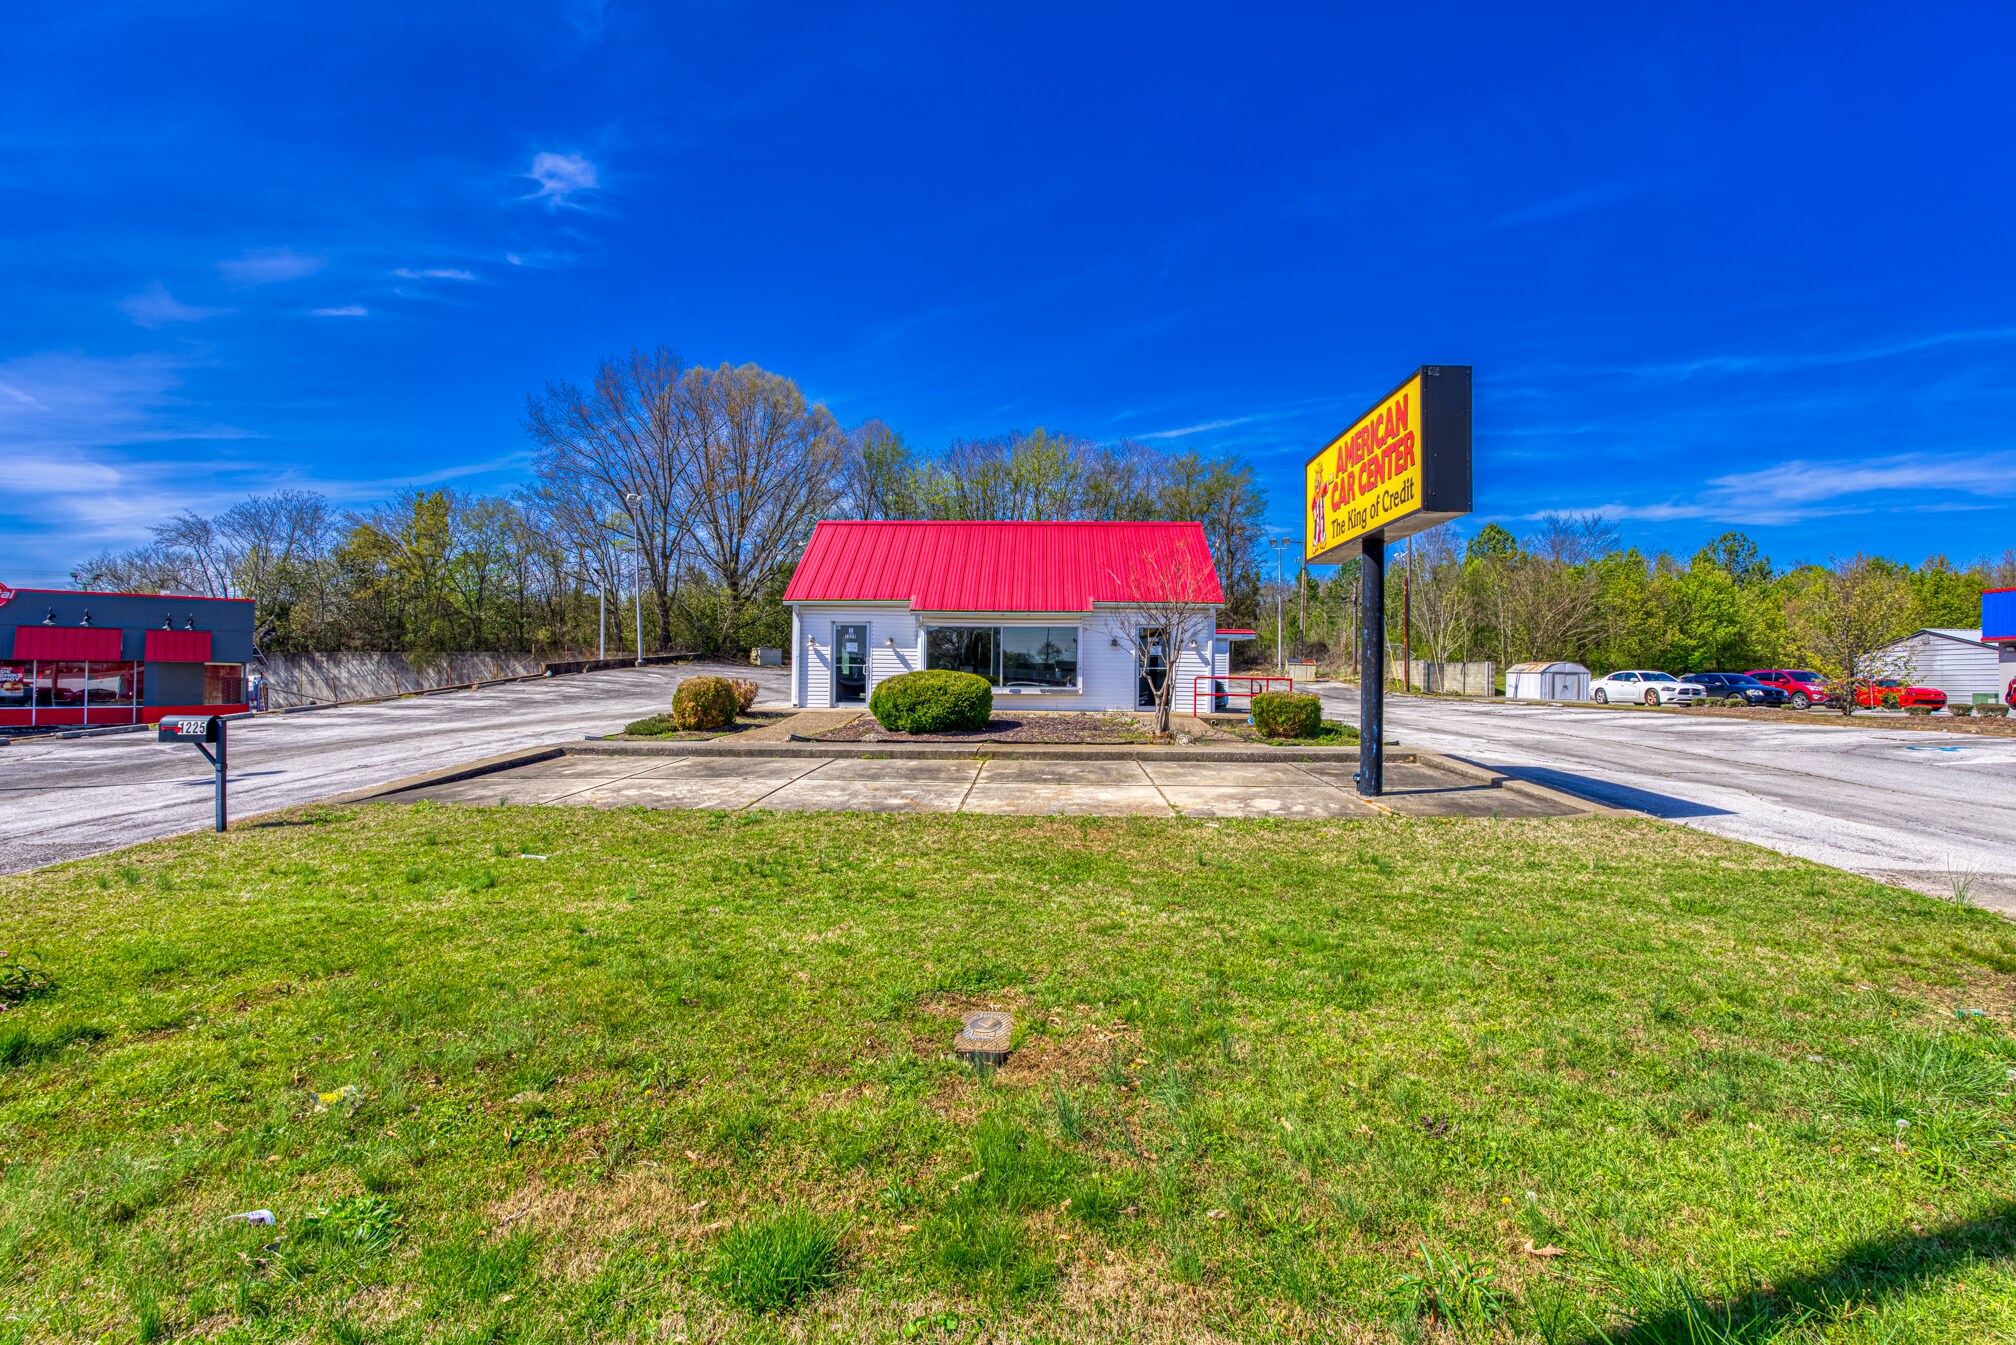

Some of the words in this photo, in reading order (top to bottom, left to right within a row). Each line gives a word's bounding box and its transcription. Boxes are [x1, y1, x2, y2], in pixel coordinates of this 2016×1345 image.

[1335, 393, 1408, 478] AMERICAN
[1331, 471, 1355, 512] CAR
[1358, 431, 1415, 496] CENTER
[1332, 518, 1346, 539] The
[1348, 507, 1367, 529] King
[1370, 494, 1380, 519] of
[1382, 477, 1414, 512] Credit
[180, 722, 205, 733] 1225
